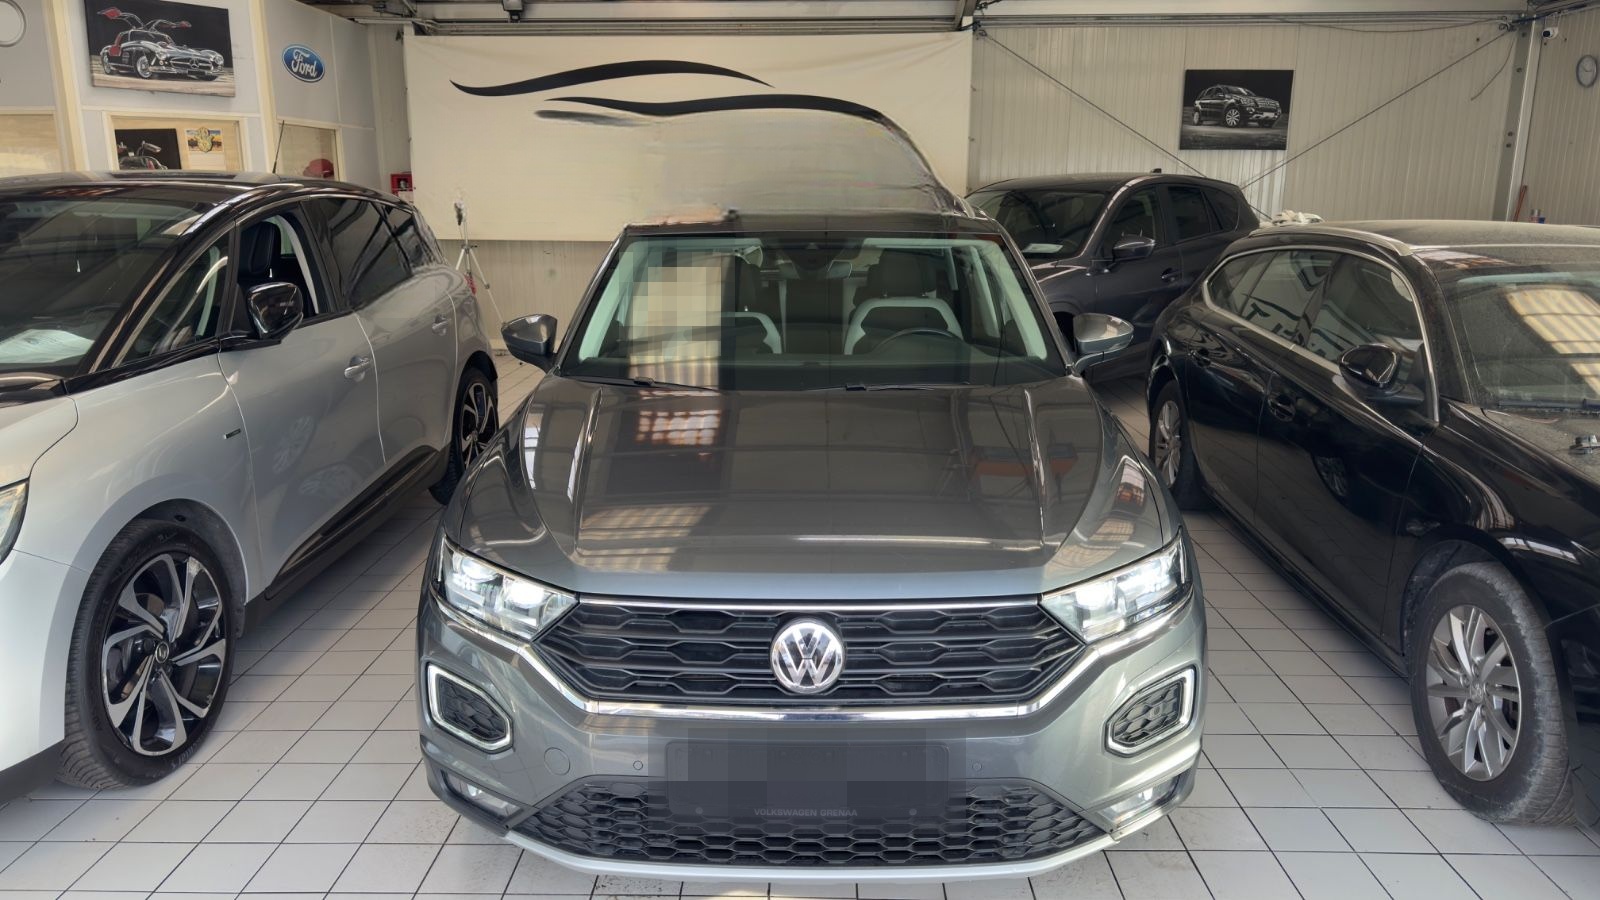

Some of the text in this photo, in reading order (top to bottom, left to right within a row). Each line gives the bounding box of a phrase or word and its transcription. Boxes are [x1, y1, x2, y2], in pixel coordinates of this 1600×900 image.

[291, 49, 318, 78] Ford
[773, 620, 844, 693] VW
[754, 808, 858, 817] VOLKSWAGEN GRENAA
